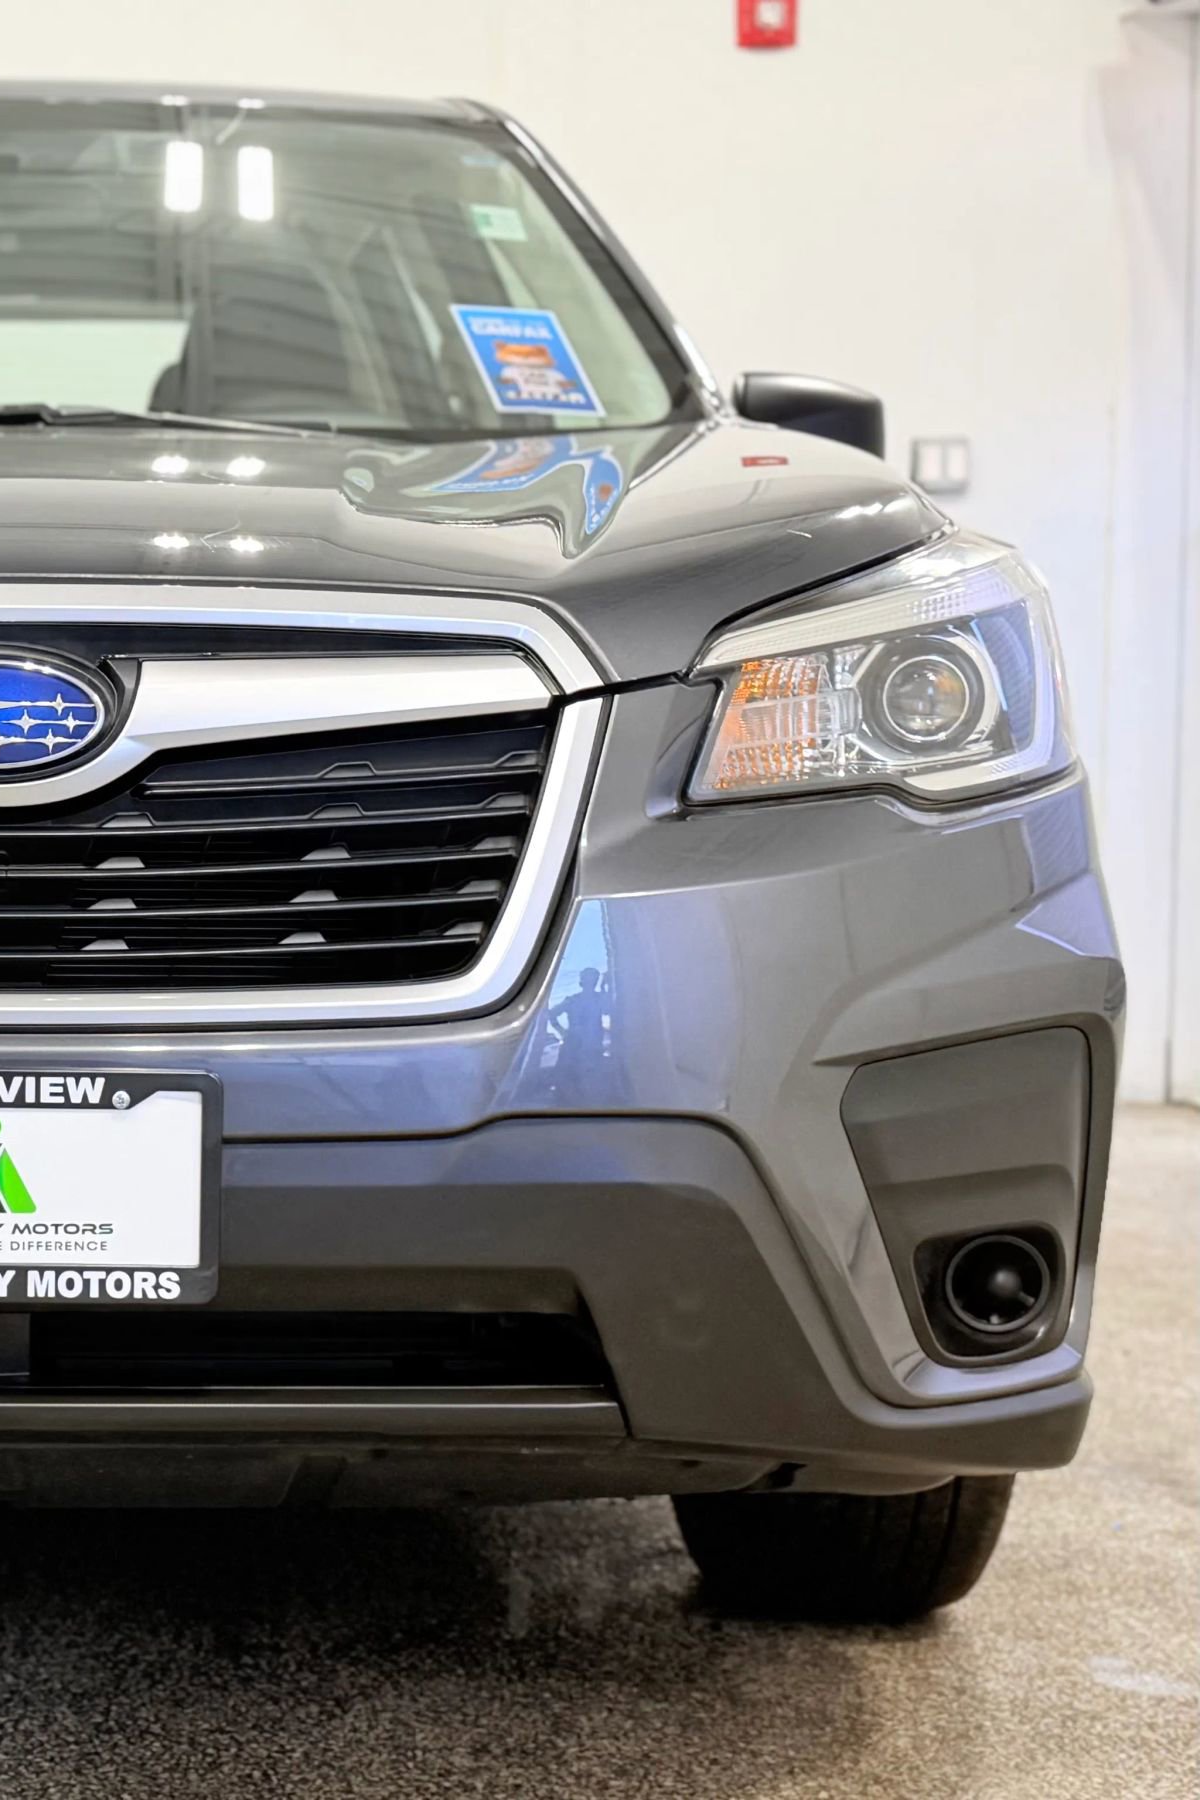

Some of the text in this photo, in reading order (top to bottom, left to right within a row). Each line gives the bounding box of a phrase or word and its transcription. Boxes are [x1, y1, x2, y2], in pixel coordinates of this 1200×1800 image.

[10, 1222, 114, 1236] MOTORS
[9, 1240, 109, 1252] DIFFERENCE
[26, 1269, 182, 1300] MOTORS
